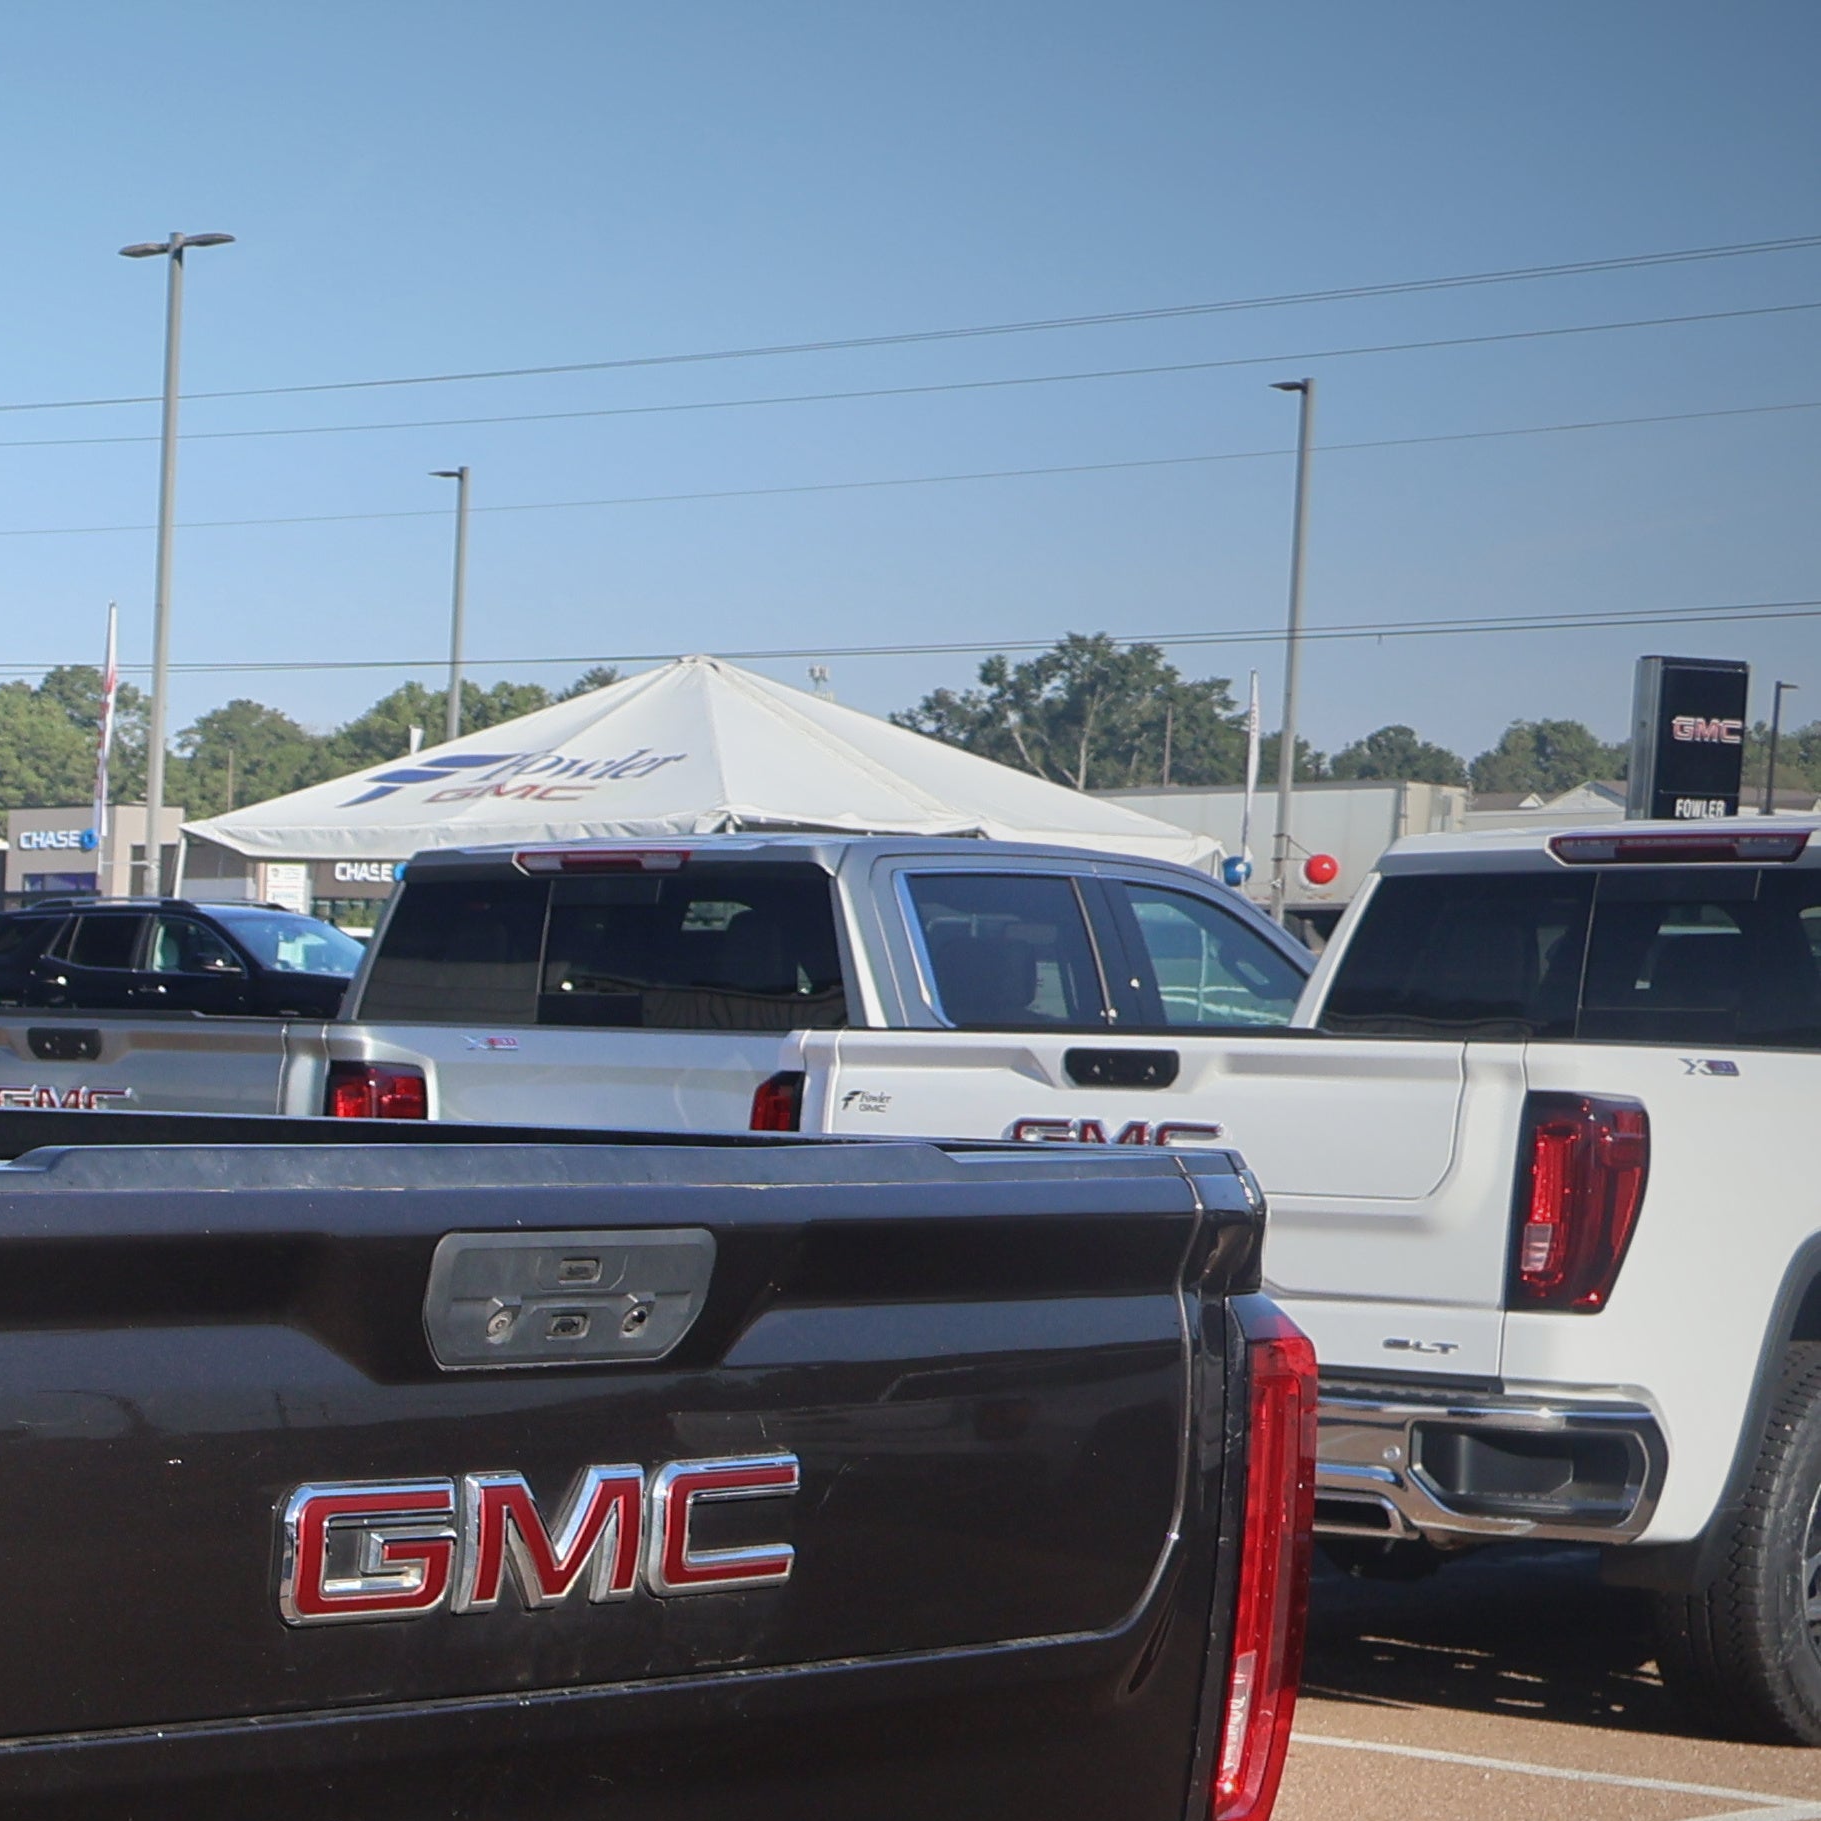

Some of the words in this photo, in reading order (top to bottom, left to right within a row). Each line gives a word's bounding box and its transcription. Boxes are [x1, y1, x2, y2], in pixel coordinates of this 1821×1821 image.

[1672, 716, 1744, 744] GMC
[470, 747, 688, 783] Fowler
[422, 782, 598, 804] GMC
[1674, 798, 1728, 819] FOWLER
[19, 829, 81, 849] CHASE
[335, 862, 394, 882] CHASE
[276, 1451, 801, 1627] GMC
